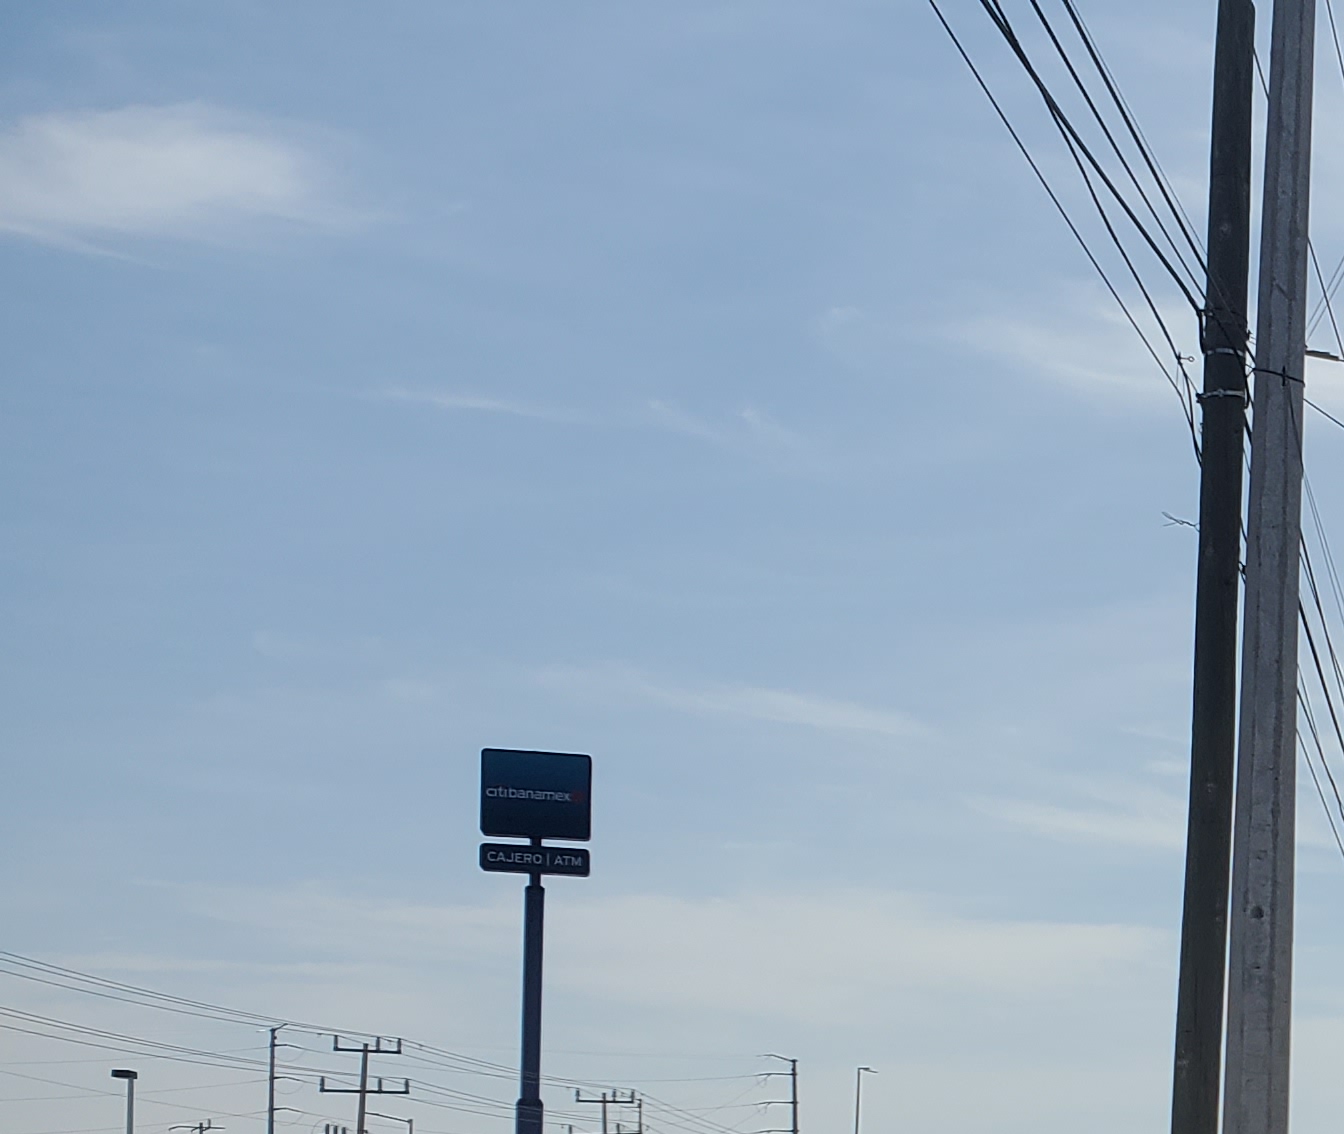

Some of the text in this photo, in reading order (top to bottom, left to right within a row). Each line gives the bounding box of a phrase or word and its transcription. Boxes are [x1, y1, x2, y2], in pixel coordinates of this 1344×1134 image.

[485, 787, 571, 801] citibanamex
[487, 851, 582, 866] CAJERO ATM
